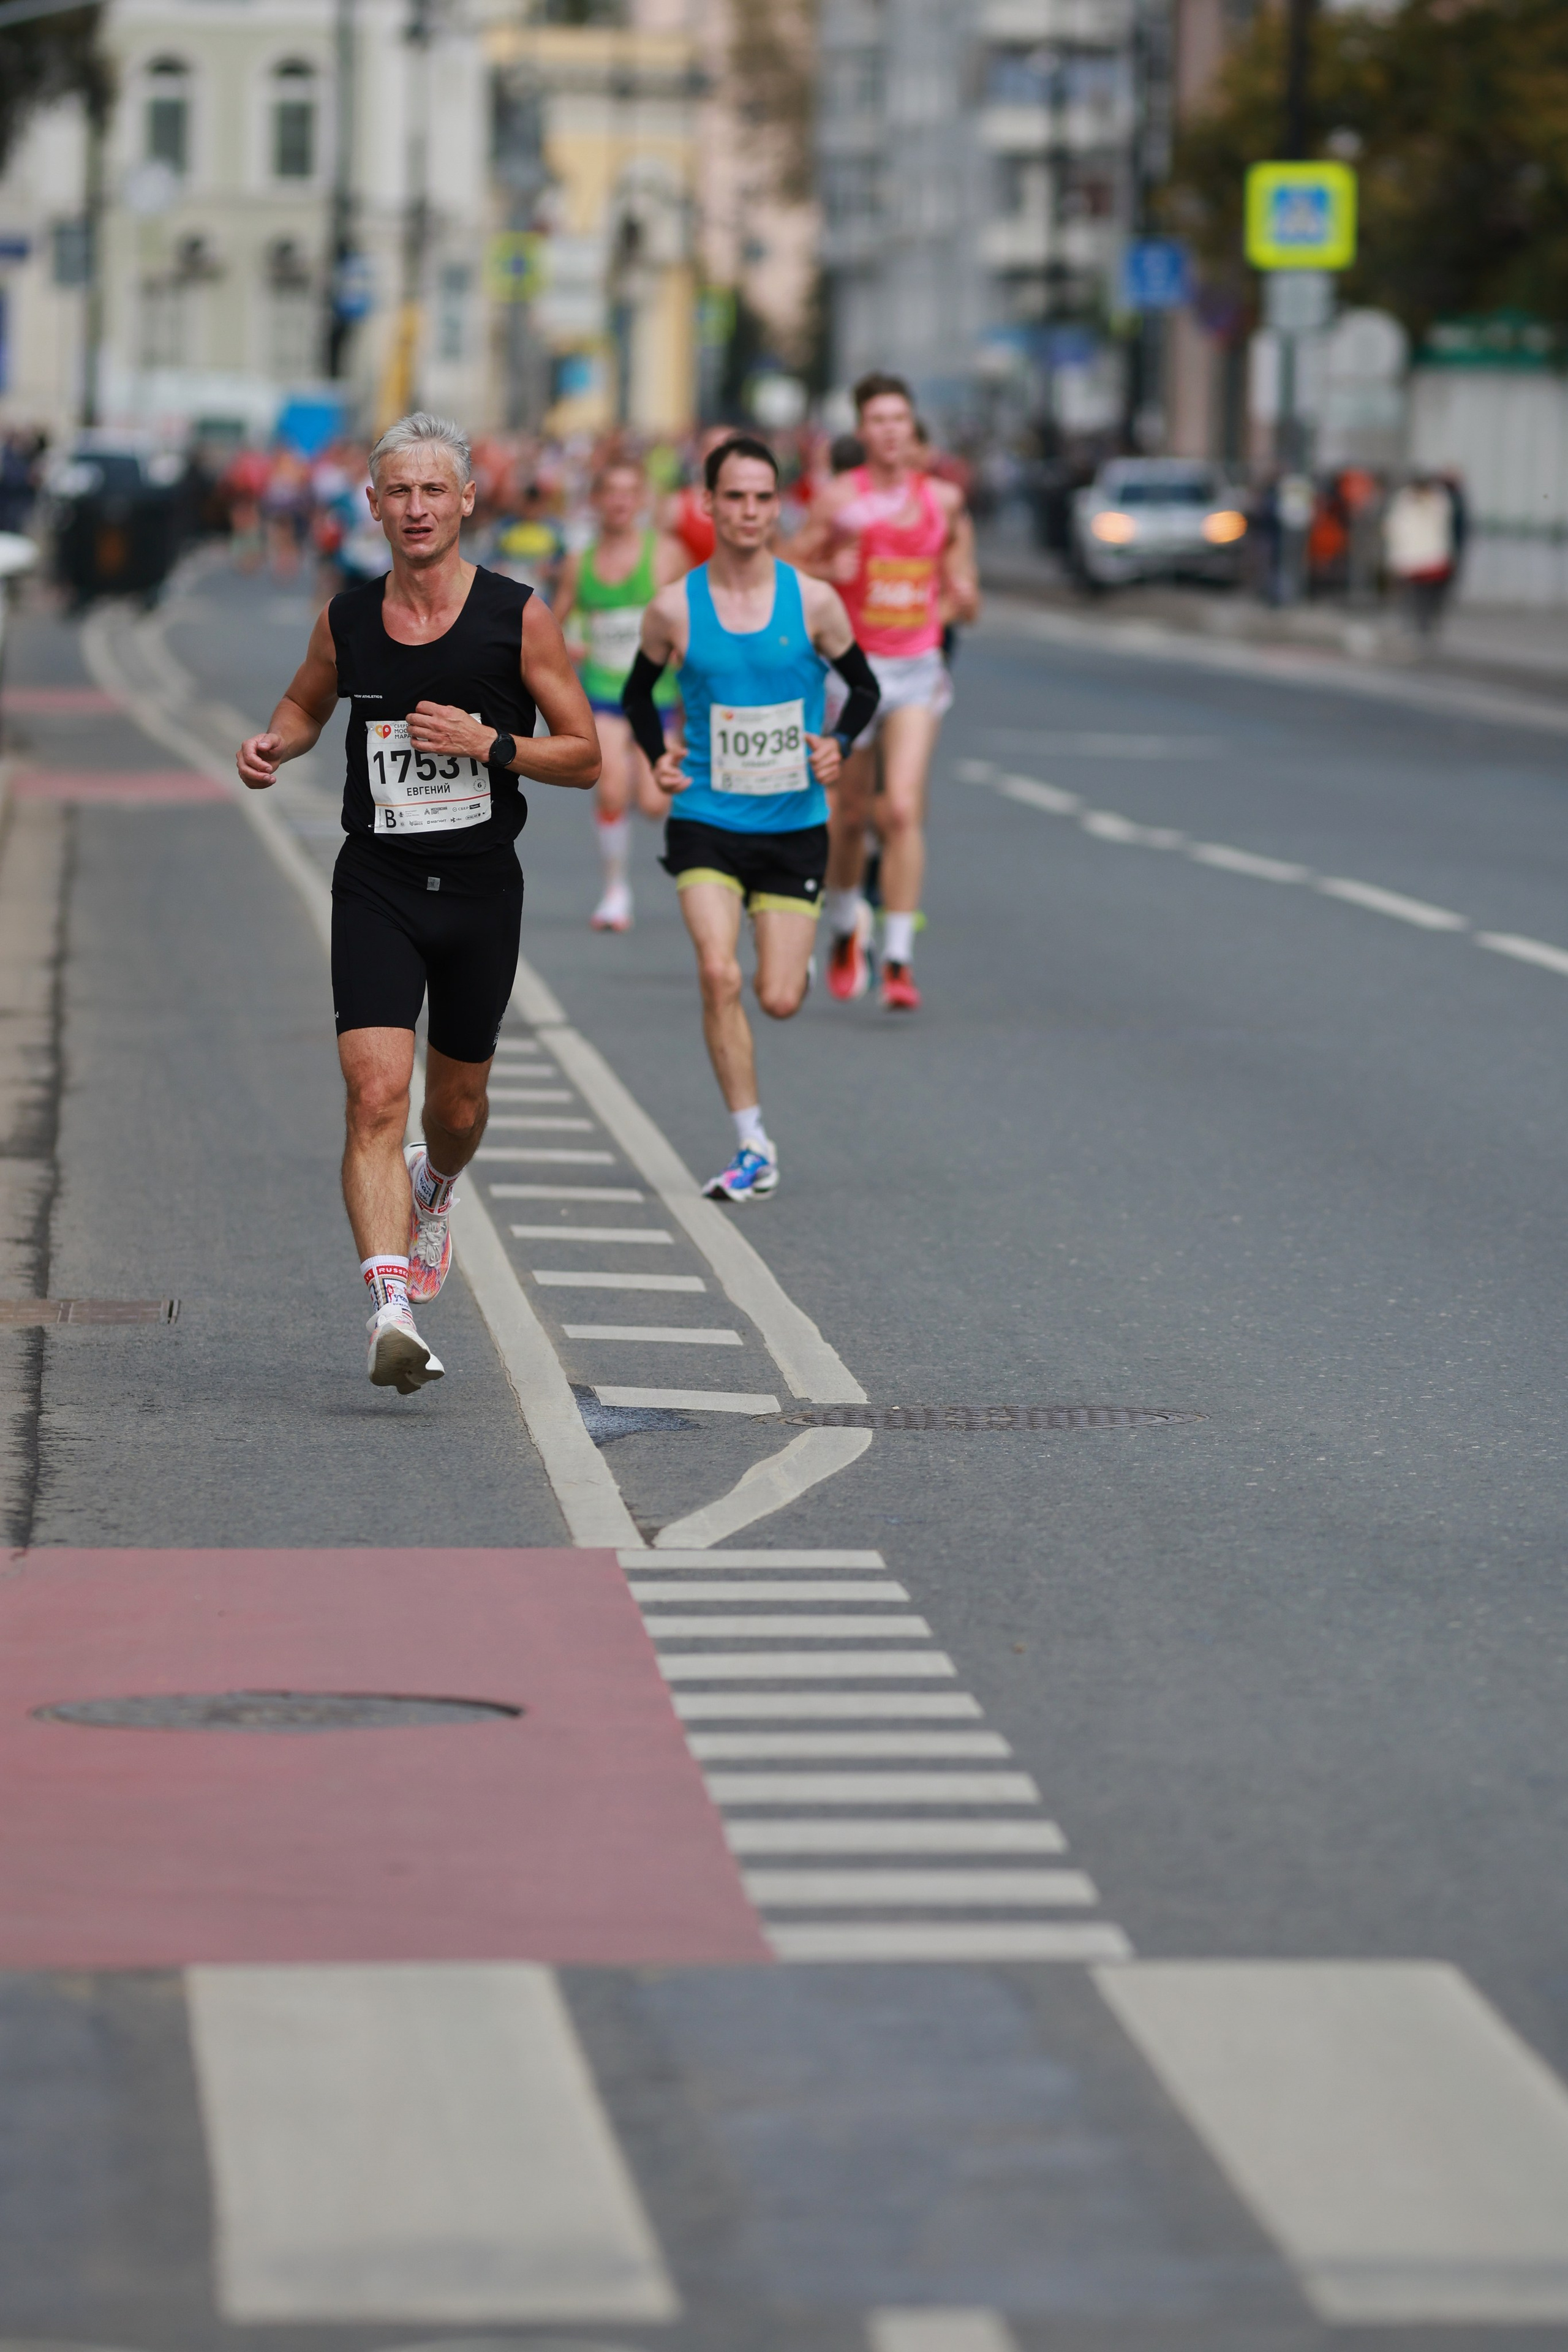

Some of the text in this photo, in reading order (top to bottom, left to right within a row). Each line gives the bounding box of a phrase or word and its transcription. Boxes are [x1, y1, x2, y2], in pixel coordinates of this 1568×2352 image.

[718, 725, 800, 756] 10938
[373, 749, 479, 785] 17531
[407, 783, 450, 796] ЕВГЕНИЙ
